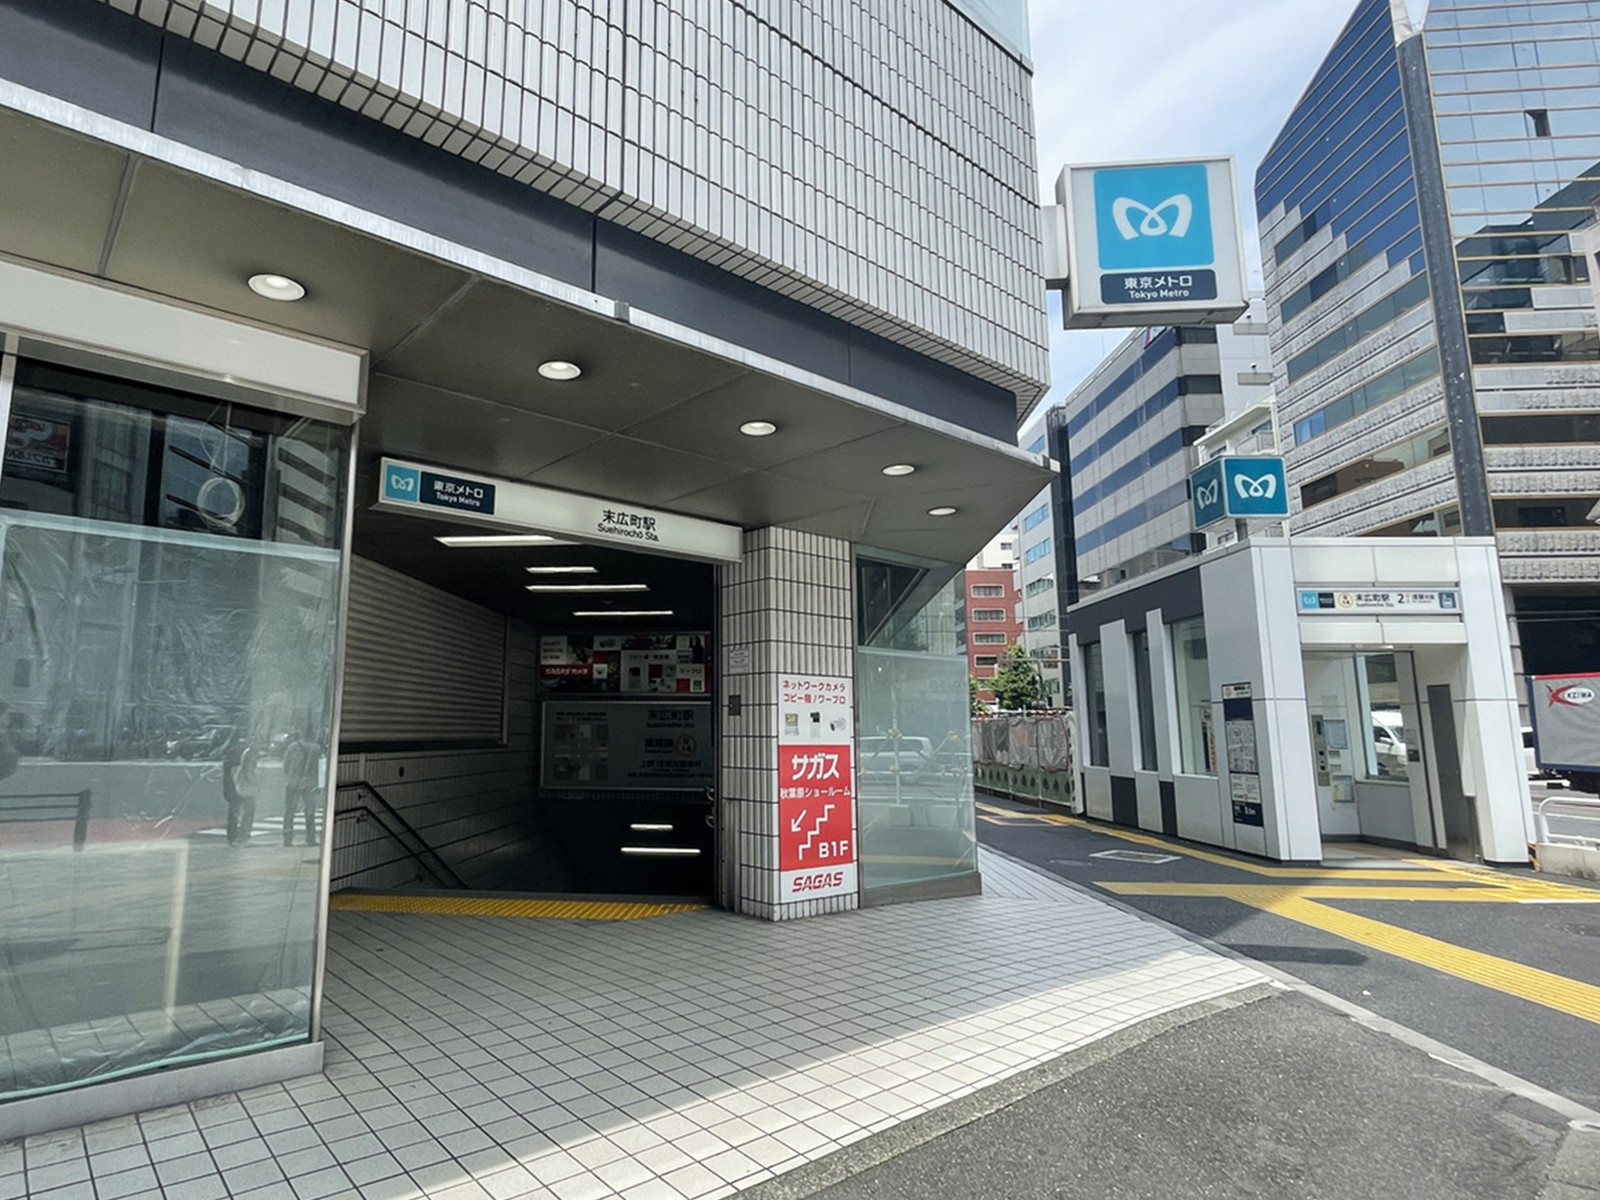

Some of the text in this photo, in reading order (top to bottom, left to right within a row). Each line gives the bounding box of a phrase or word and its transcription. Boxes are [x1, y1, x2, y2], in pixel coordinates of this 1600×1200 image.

[1124, 275, 1193, 290] 東京メトロ
[1129, 288, 1190, 300] Tokyo Metro
[433, 480, 484, 499] 東京メトロ
[436, 491, 481, 507] Tokyo Metro
[602, 509, 656, 532] 末広町駅
[1397, 593, 1405, 604] 2
[783, 680, 846, 692] ネットワークカメラ
[791, 752, 840, 780] サガス
[779, 785, 851, 799] 秋葉原ショールーム
[818, 840, 849, 859] B1F
[791, 871, 843, 893] SAGAS
